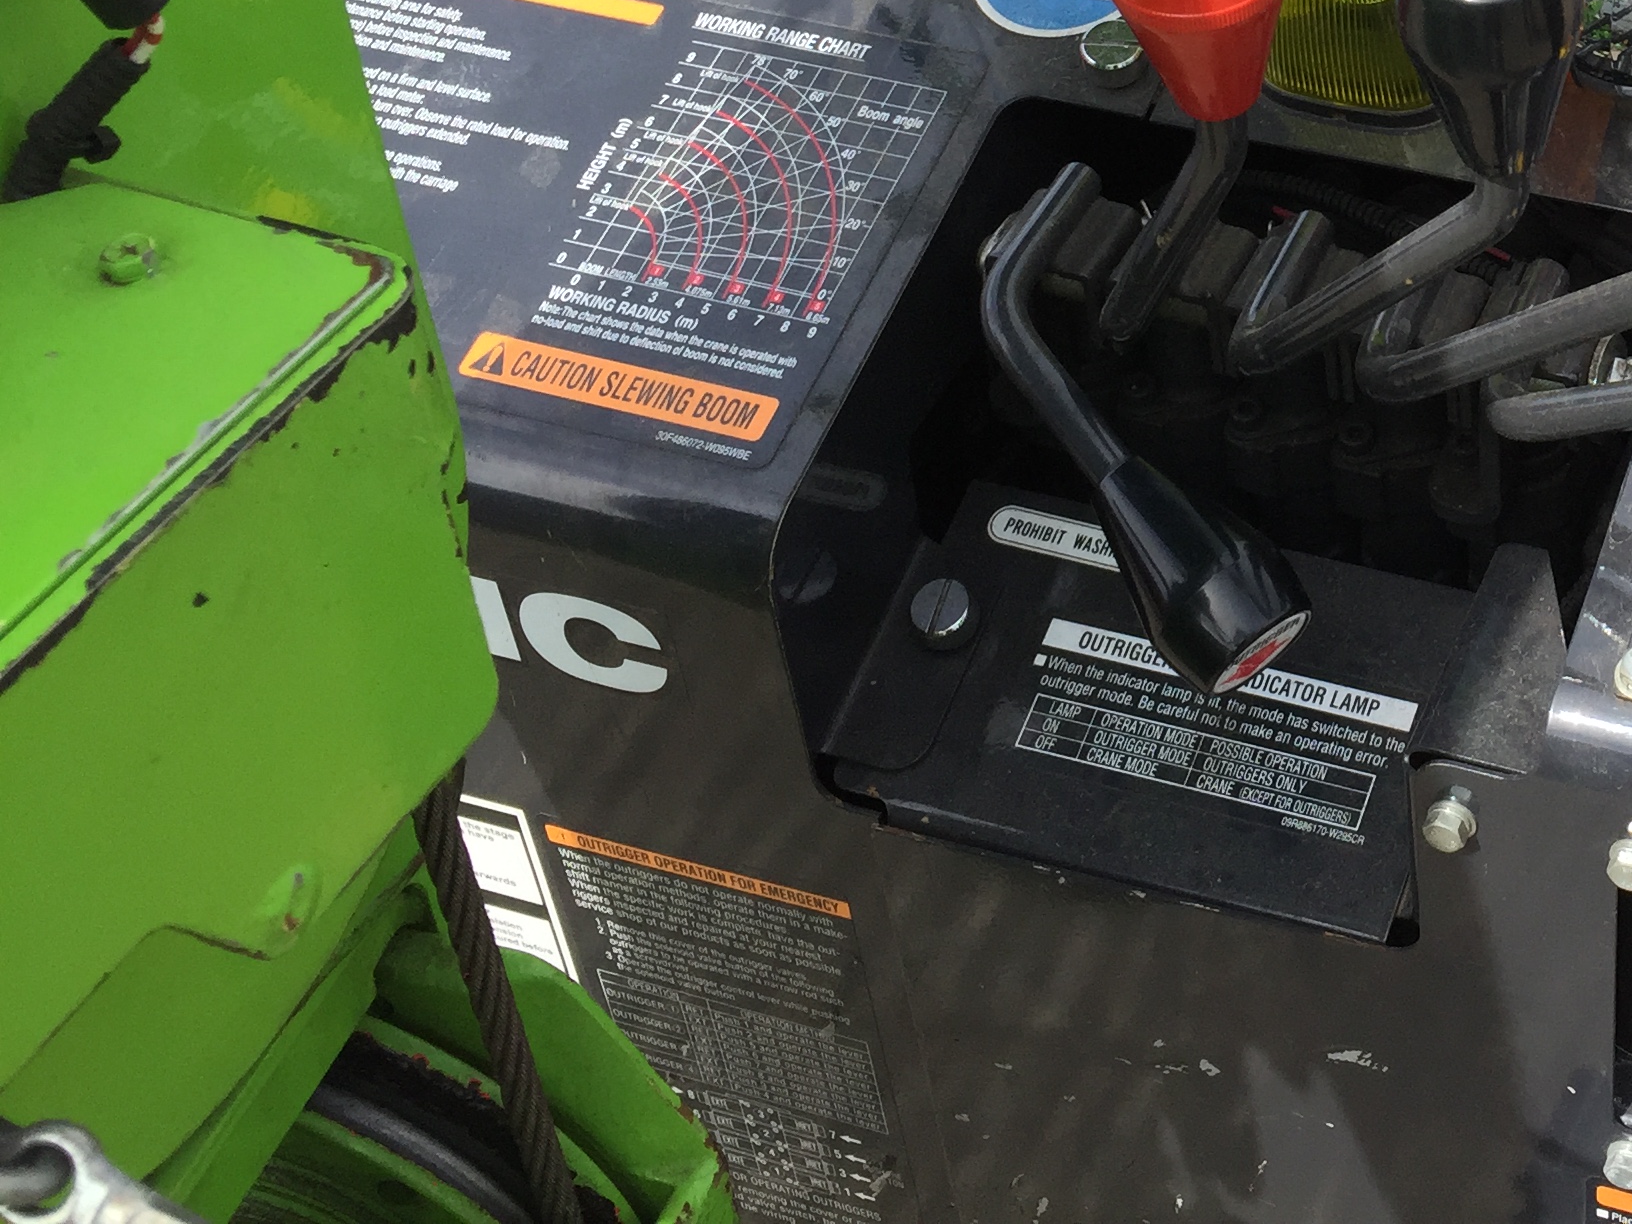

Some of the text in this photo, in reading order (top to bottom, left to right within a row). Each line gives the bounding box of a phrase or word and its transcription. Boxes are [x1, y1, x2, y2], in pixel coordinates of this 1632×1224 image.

[694, 12, 872, 59] WORKING RANGE CHART
[434, 79, 458, 96] level
[857, 106, 924, 130] Boom angle
[381, 118, 428, 137] outriggers
[415, 107, 452, 127] Observe
[466, 119, 492, 134] rated
[490, 123, 515, 139] load
[576, 118, 633, 190] HEIGHT (m)
[420, 172, 459, 193] carriage
[548, 285, 699, 331] WORKING RADIUS (m)
[578, 311, 797, 368] chart shows the data when the crane operated with
[629, 336, 671, 354] deflection
[511, 350, 759, 430] CAUTION SLEWING BOOM
[1003, 517, 1115, 558] PROHIBIT WASH
[1049, 655, 1406, 753] When the indicator lamp the mode has switched to the
[1078, 631, 1380, 717] OUTRIGGE DICATOR LAMP
[1040, 675, 1389, 769] outrigger mode. Be careful to make an operating error.
[1049, 704, 1328, 780] LAMP OPERATION MODE POSSIBLE OPERATION
[1035, 735, 1352, 824] OFF CRANE MODE CRANE (EXCEPT FOR OUTRIGGERS)
[1042, 718, 1307, 793] ON OUTRIGGER MODE OUTRIGGERS ONLY
[558, 847, 834, 927] When outriggers operate normally with
[577, 836, 838, 913] OUTRIGGER OPERATION FOR EMERGENCY
